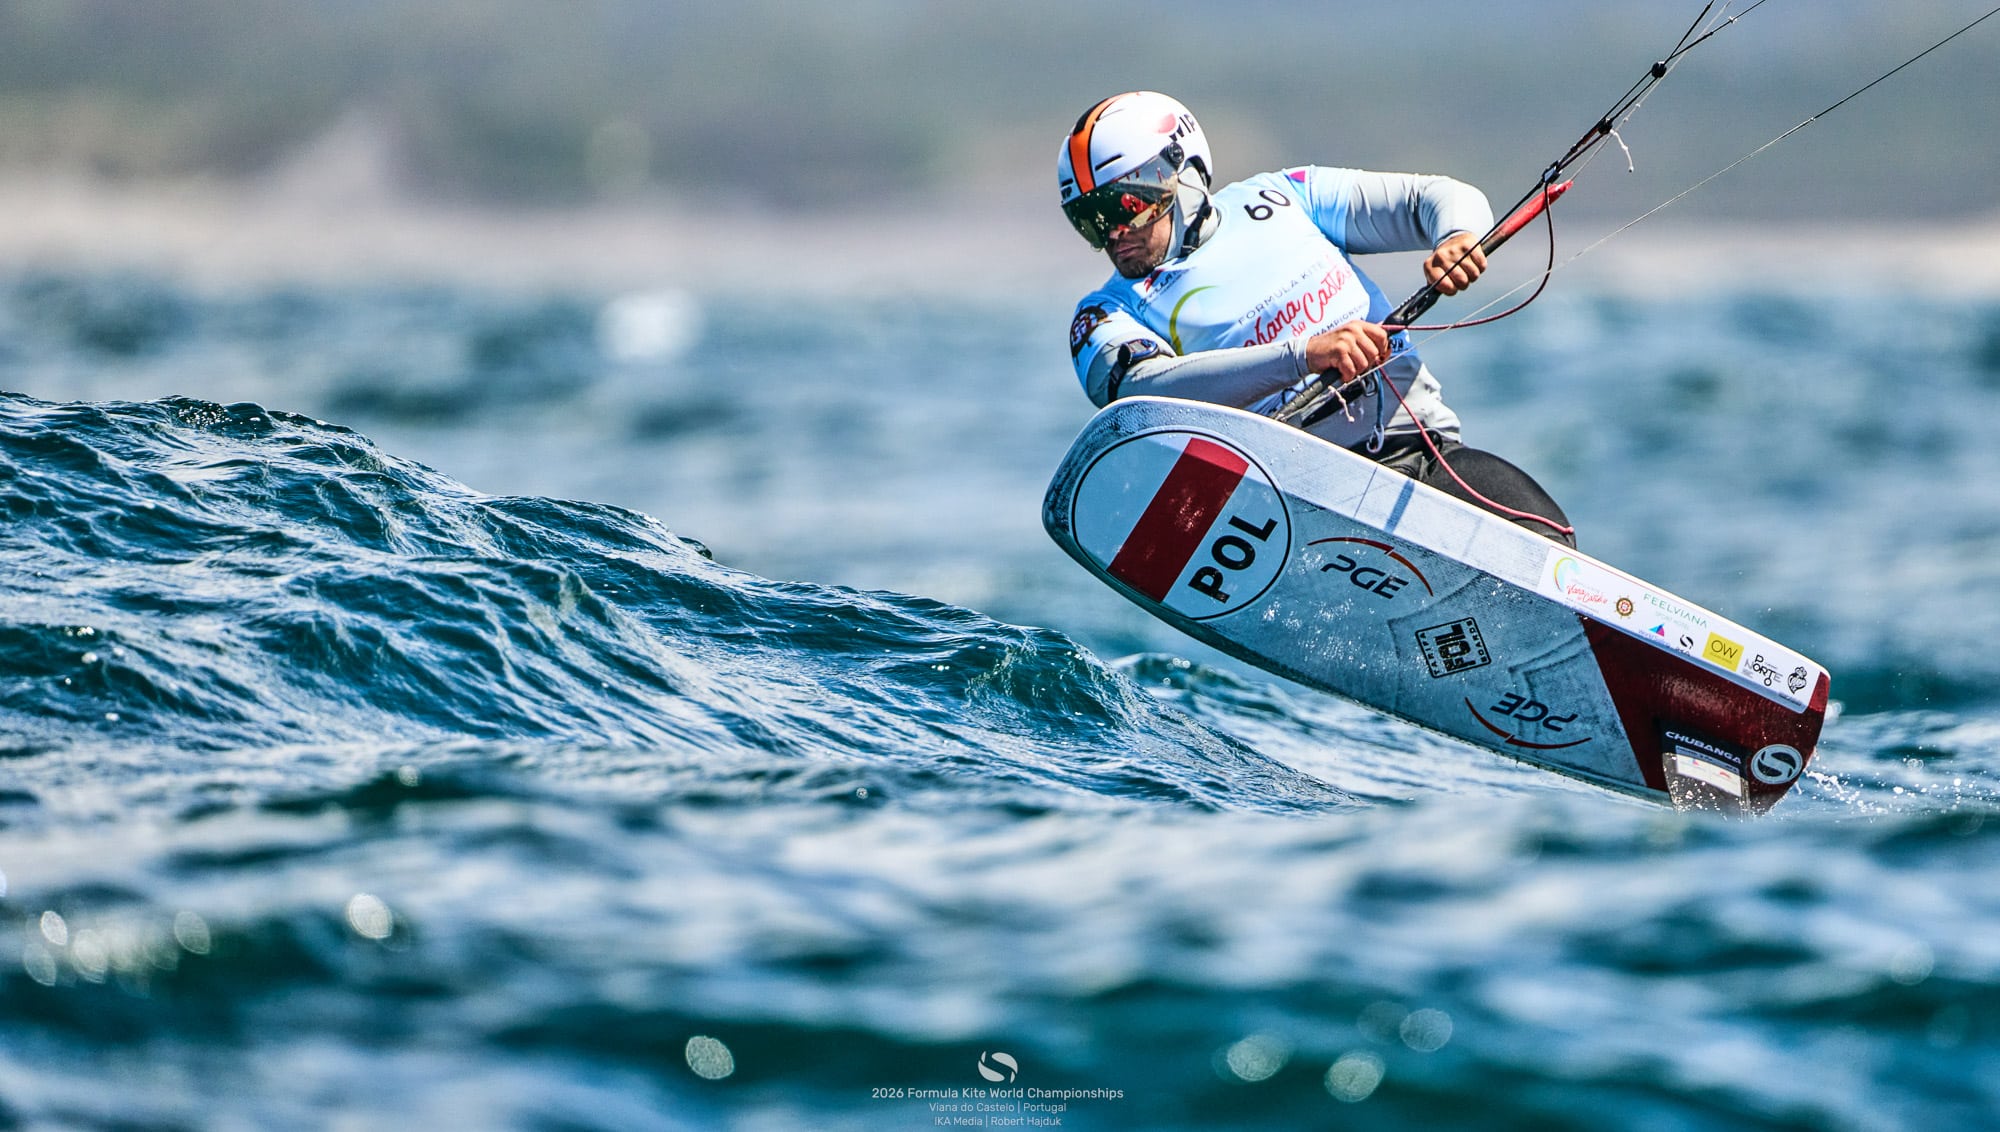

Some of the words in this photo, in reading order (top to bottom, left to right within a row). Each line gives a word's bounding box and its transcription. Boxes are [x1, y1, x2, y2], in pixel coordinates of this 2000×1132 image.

[1244, 190, 1291, 221] 60
[1238, 279, 1298, 325] FORMULA
[1189, 514, 1278, 604] POL
[1321, 553, 1409, 599] PGE
[1643, 593, 1708, 629] FEELVIANA
[1420, 632, 1440, 675] TARIFA
[1434, 623, 1476, 672] FOIL
[1466, 620, 1487, 662] BOARDS
[1711, 640, 1738, 659] OW
[1490, 691, 1578, 733] PGE
[1665, 731, 1742, 764] CHUBANGA
